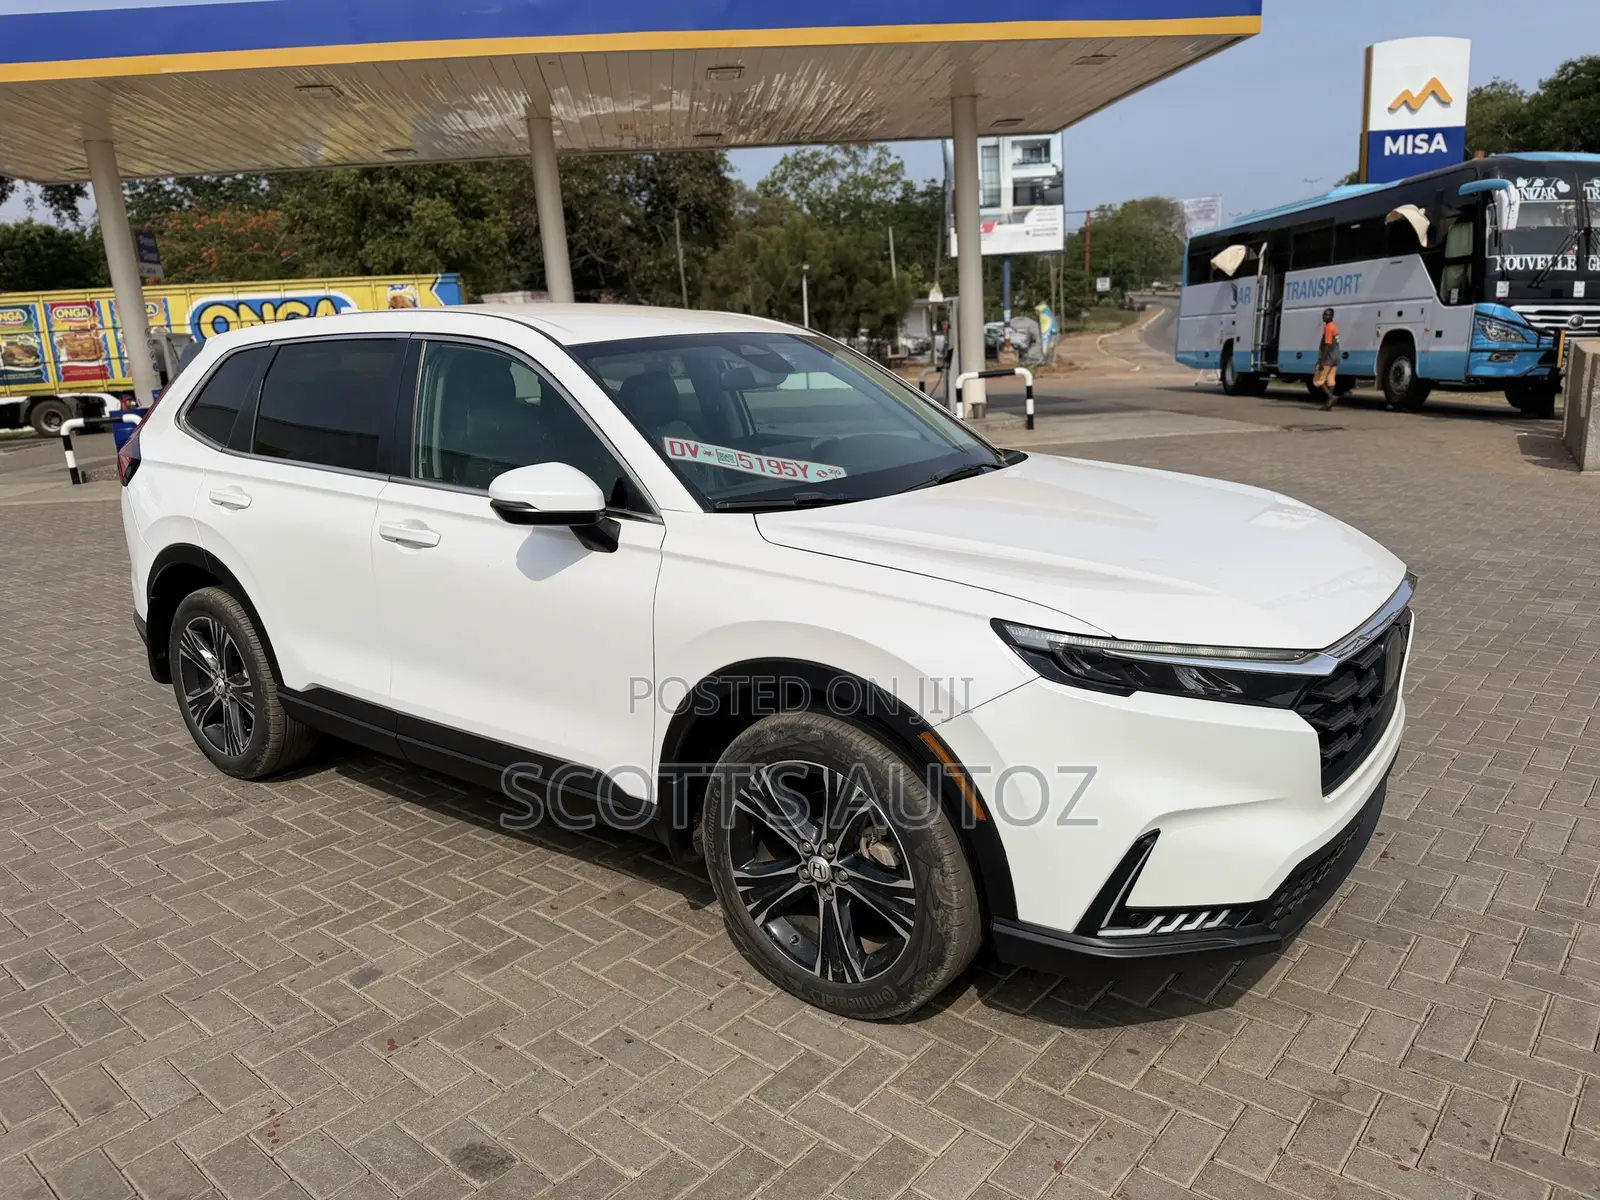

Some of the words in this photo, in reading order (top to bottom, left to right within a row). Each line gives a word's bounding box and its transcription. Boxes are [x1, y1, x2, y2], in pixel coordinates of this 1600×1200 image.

[1384, 132, 1448, 156] MISA
[1520, 187, 1558, 201] NIZAR
[1285, 273, 1363, 301] TRANSPORT
[55, 306, 90, 319] ONGA
[669, 440, 699, 459] DV
[737, 453, 809, 479] 5195Y
